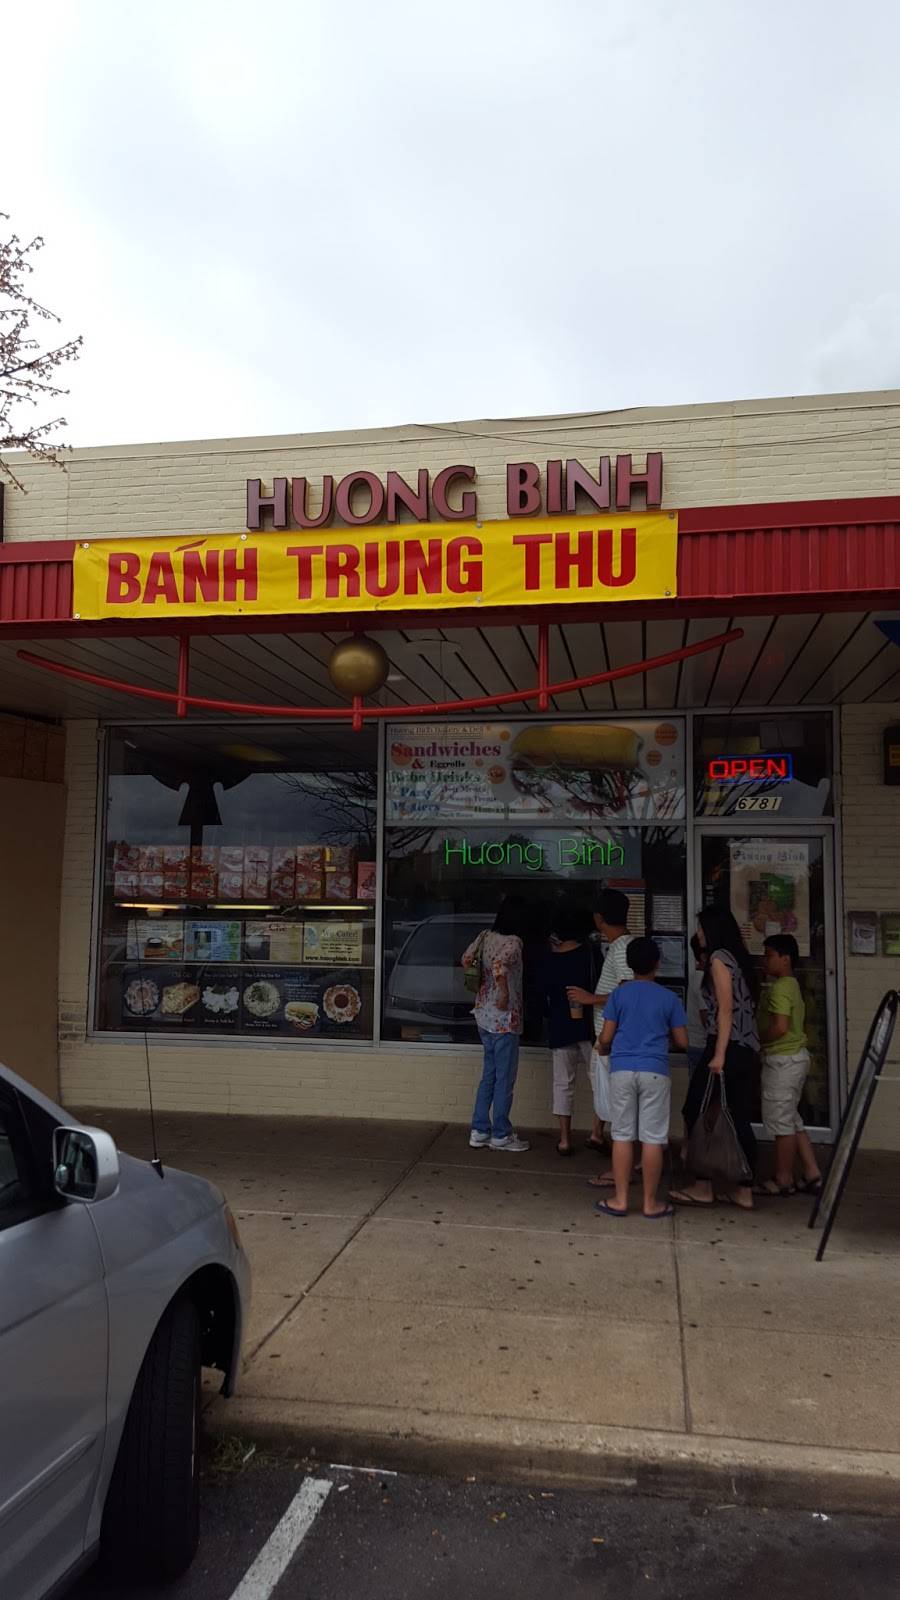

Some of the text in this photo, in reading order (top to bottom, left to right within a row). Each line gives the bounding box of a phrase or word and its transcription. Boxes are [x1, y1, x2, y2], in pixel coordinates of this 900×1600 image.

[246, 452, 663, 530] HUONG BINH
[286, 535, 484, 600] TRUNG
[513, 527, 637, 591] THU
[391, 742, 502, 757] Sandwiches
[411, 758, 466, 769] & Eggrolls
[708, 758, 787, 779] OPEN
[738, 796, 778, 810] 6781
